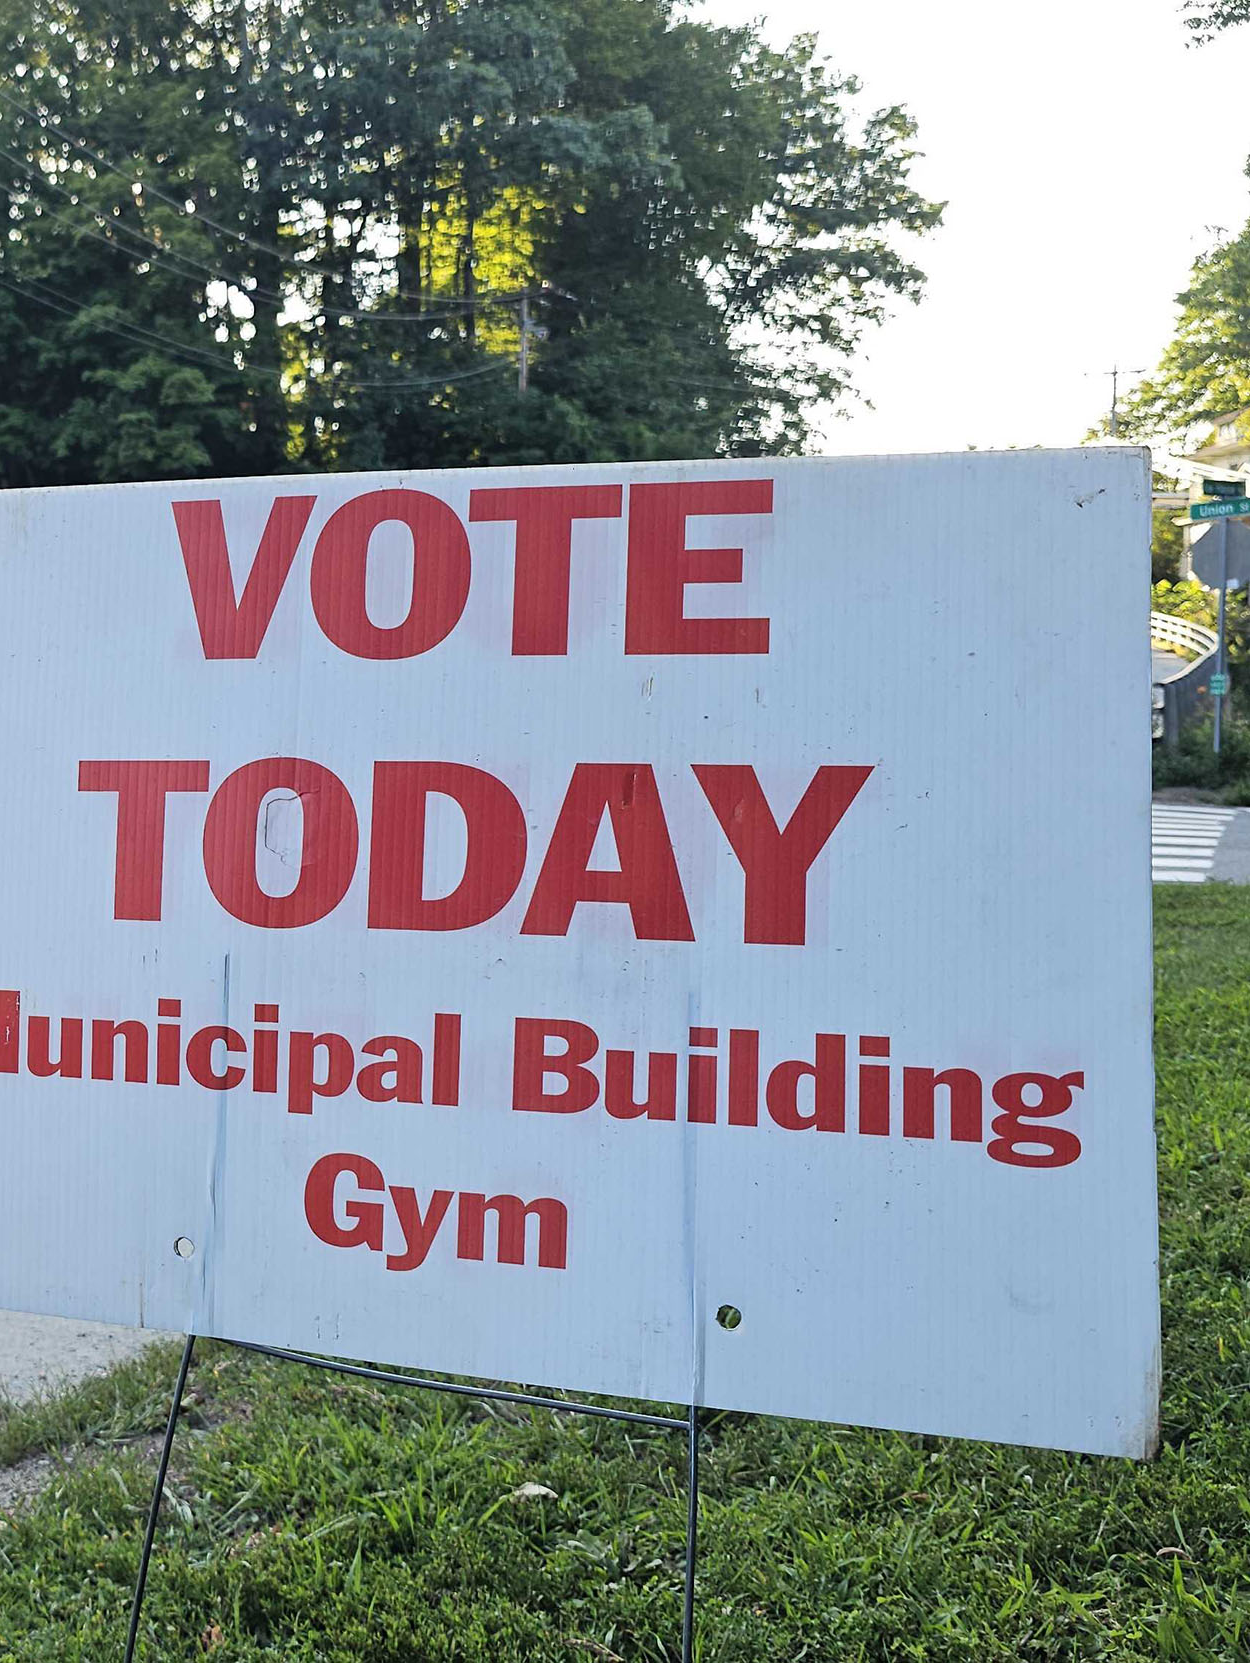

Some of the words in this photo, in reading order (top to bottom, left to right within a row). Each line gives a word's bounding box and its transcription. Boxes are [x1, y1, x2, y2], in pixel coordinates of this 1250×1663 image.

[174, 480, 773, 660] VOTE
[1199, 503, 1234, 517] Union
[79, 758, 874, 946] TODAY
[512, 1017, 1083, 1168] Building
[304, 1153, 568, 1271] Gym
